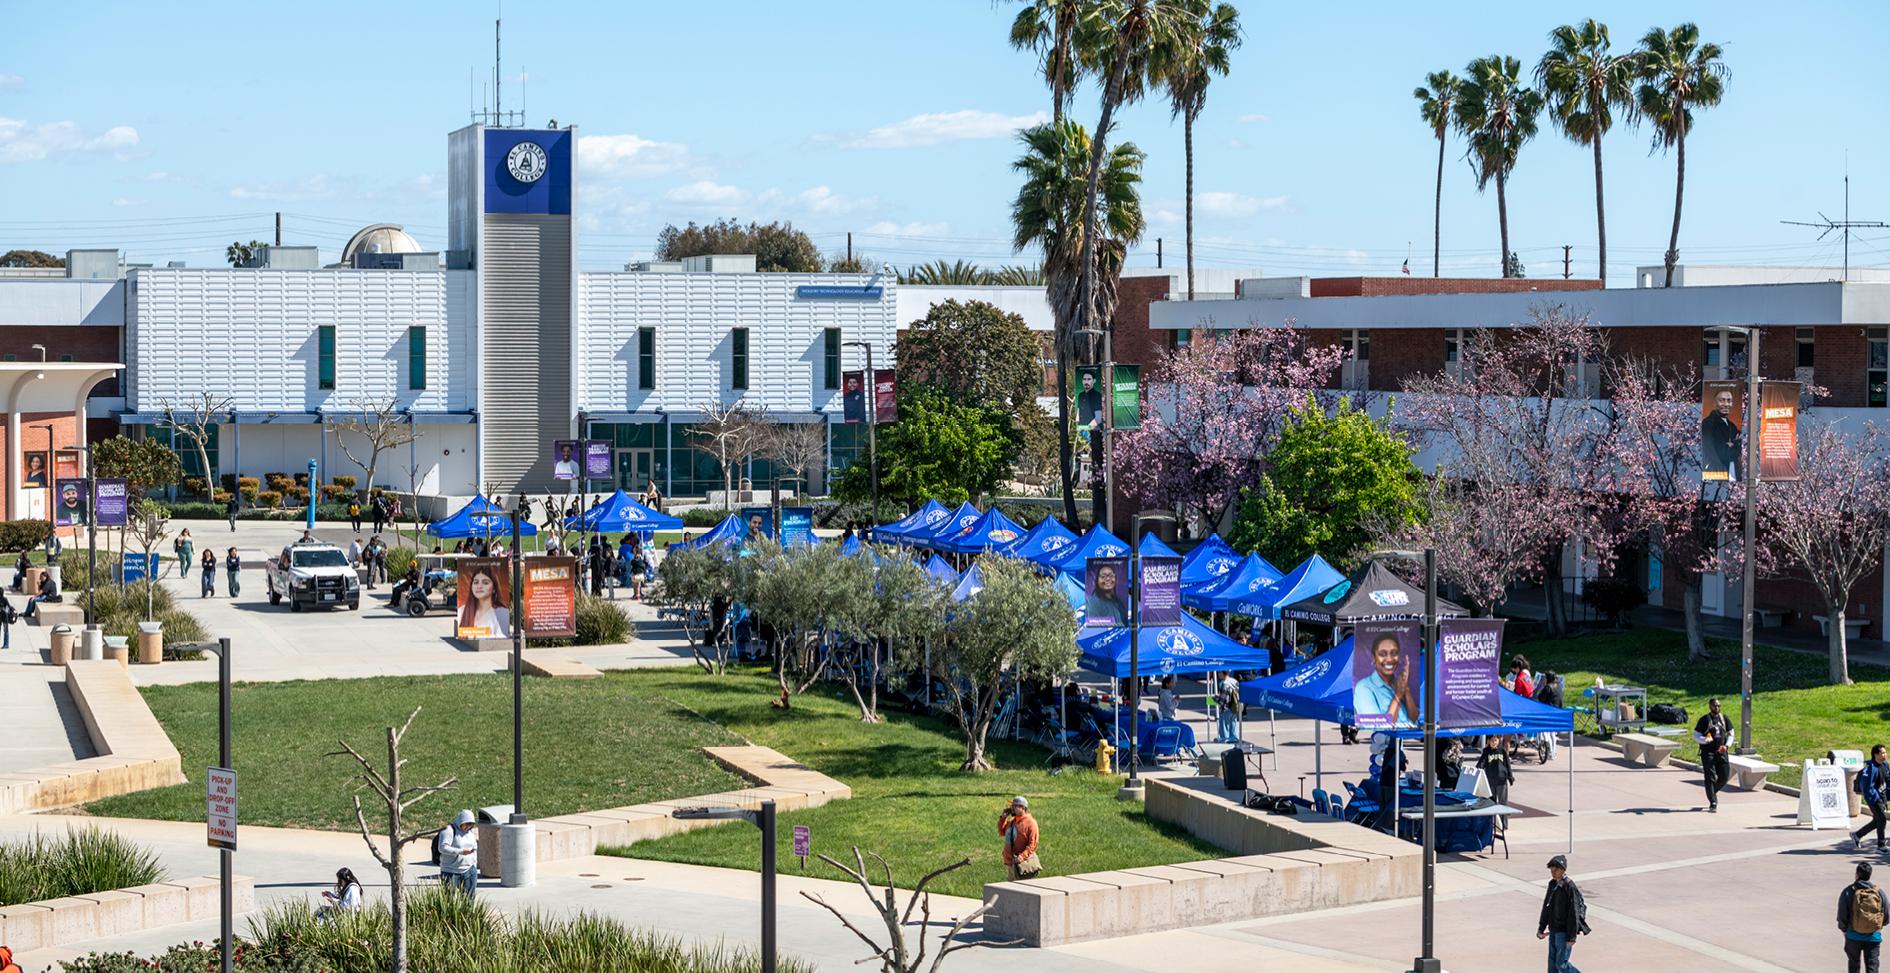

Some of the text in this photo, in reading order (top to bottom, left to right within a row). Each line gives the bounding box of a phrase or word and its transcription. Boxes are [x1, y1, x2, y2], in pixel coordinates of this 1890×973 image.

[518, 143, 545, 160] CAMINO
[511, 167, 544, 180] COLLEGE
[1766, 408, 1793, 418] MESA
[531, 567, 568, 581] MESA
[1144, 576, 1178, 584] PROGRAM
[1290, 609, 1309, 620] CAMINO
[1309, 613, 1331, 623] COLLEGE
[1347, 615, 1357, 624] EL
[1362, 613, 1406, 622] CAMINO
[1165, 628, 1198, 642] CAMINO
[1444, 632, 1497, 644] GUARDIAN
[1444, 640, 1497, 653] SCHOLARS
[1445, 649, 1496, 662] PROGRAM
[211, 775, 233, 785] PICK-UP
[216, 786, 228, 794] AND
[208, 794, 235, 805] DROP-OFF
[215, 804, 229, 814] ZONE
[218, 819, 227, 827] NO
[210, 826, 234, 839] PARKING
